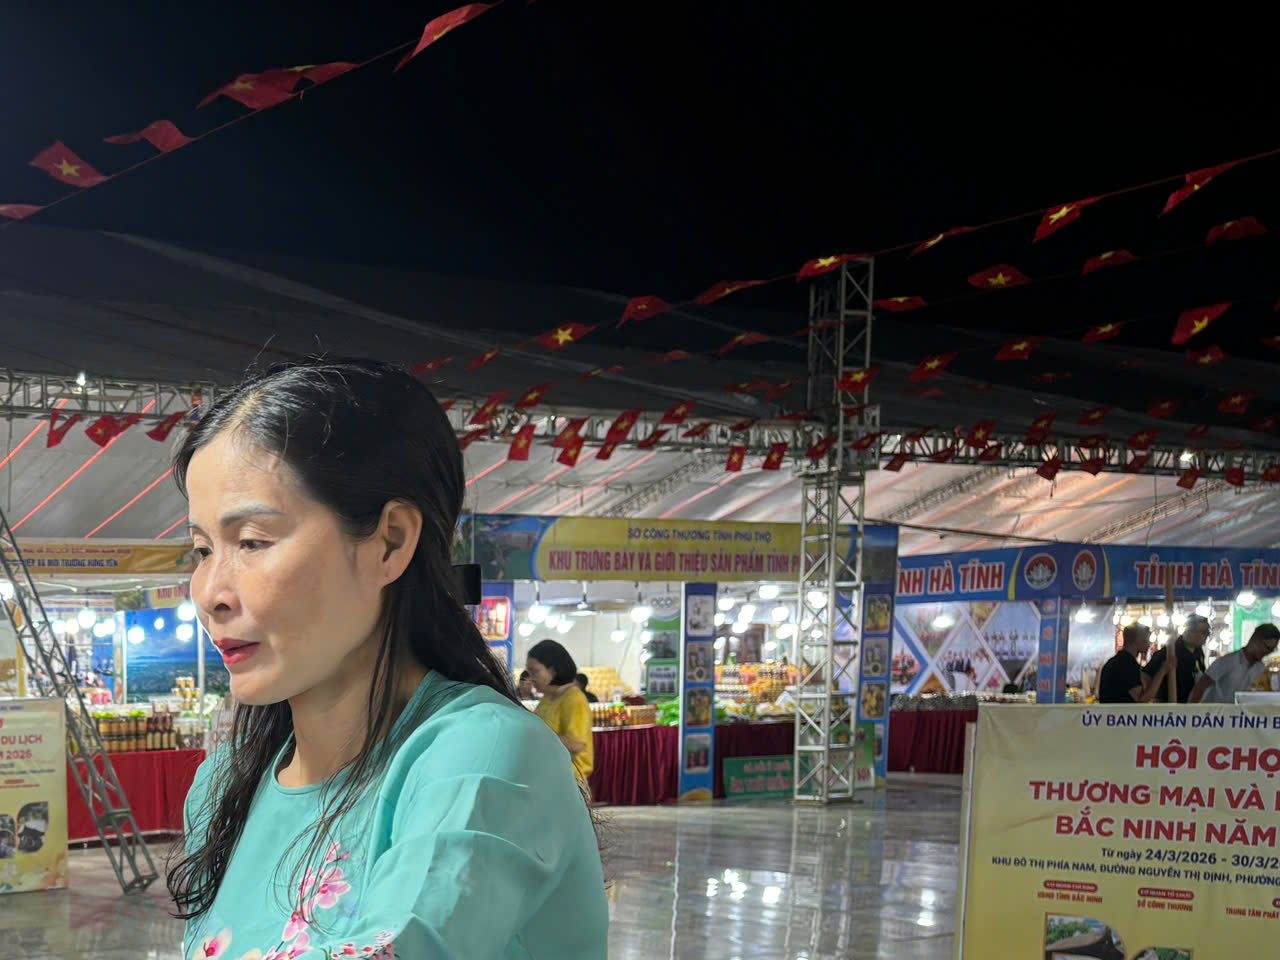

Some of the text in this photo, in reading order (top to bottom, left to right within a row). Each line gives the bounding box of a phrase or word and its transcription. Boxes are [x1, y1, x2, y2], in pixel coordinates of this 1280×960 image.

[643, 528, 670, 540] CÔNG
[549, 551, 571, 571] KHU
[1201, 559, 1233, 587] HÀ
[1240, 560, 1280, 588] TĨN
[928, 560, 954, 594] HÀ
[1082, 710, 1268, 729] ỦY BAN NHÂN DÂN TỈNH
[1, 735, 16, 745] DU
[1136, 738, 1198, 774] HỘI
[1029, 779, 1265, 813] THƯƠNG MẠI VÀ
[1056, 806, 1276, 847] BẮC NINH NĂM
[992, 856, 1011, 867] KHU
[1014, 855, 1027, 867] ĐÔ
[1030, 859, 1044, 871] THỊ
[1047, 859, 1070, 871] PHÍA
[1072, 862, 1097, 874] NAM,
[1100, 863, 1135, 876] ĐƯỜNG
[1138, 865, 1180, 879] NGUYỄN
[1183, 870, 1200, 882] THỊ
[1203, 871, 1232, 884] ĐỊNH,
[1117, 849, 1142, 862] ngày
[1145, 849, 1217, 865] 24/3/2026
[1231, 854, 1280, 869] 30/3/2
